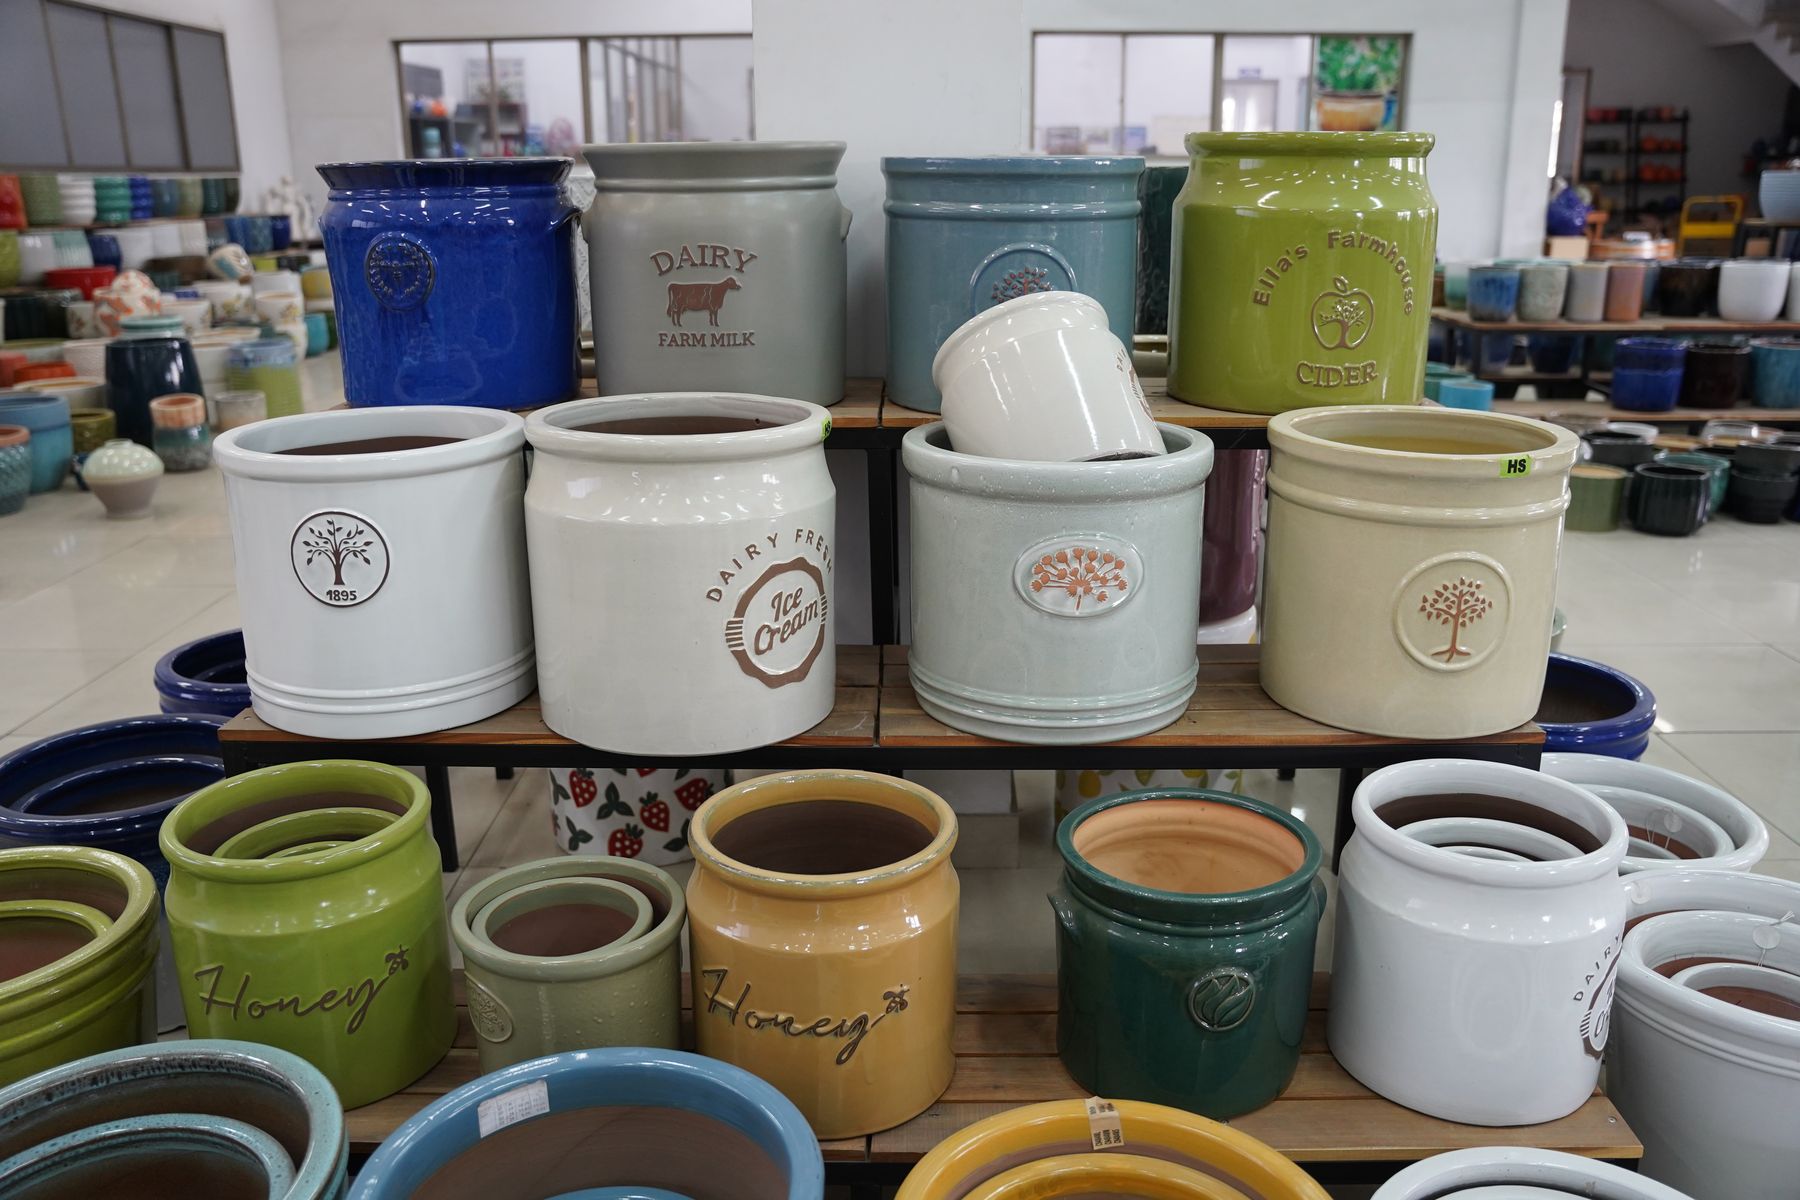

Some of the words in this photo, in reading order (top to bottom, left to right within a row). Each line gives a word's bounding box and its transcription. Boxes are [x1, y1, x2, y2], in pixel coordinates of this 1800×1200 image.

[650, 243, 757, 276] DAIRY
[1252, 243, 1310, 306] Ella's
[1327, 229, 1414, 315] Farmhouse
[658, 331, 707, 347] FARM
[710, 331, 756, 347] MILK
[1296, 361, 1379, 388] CIDER
[1507, 458, 1527, 474] HS
[706, 532, 778, 602] DAIRY
[795, 528, 832, 574] FRESH
[326, 589, 357, 601] 1895
[771, 587, 804, 623] Ice
[753, 600, 820, 656] Cream
[194, 964, 391, 1035] Honey
[702, 967, 887, 1066] Honey
